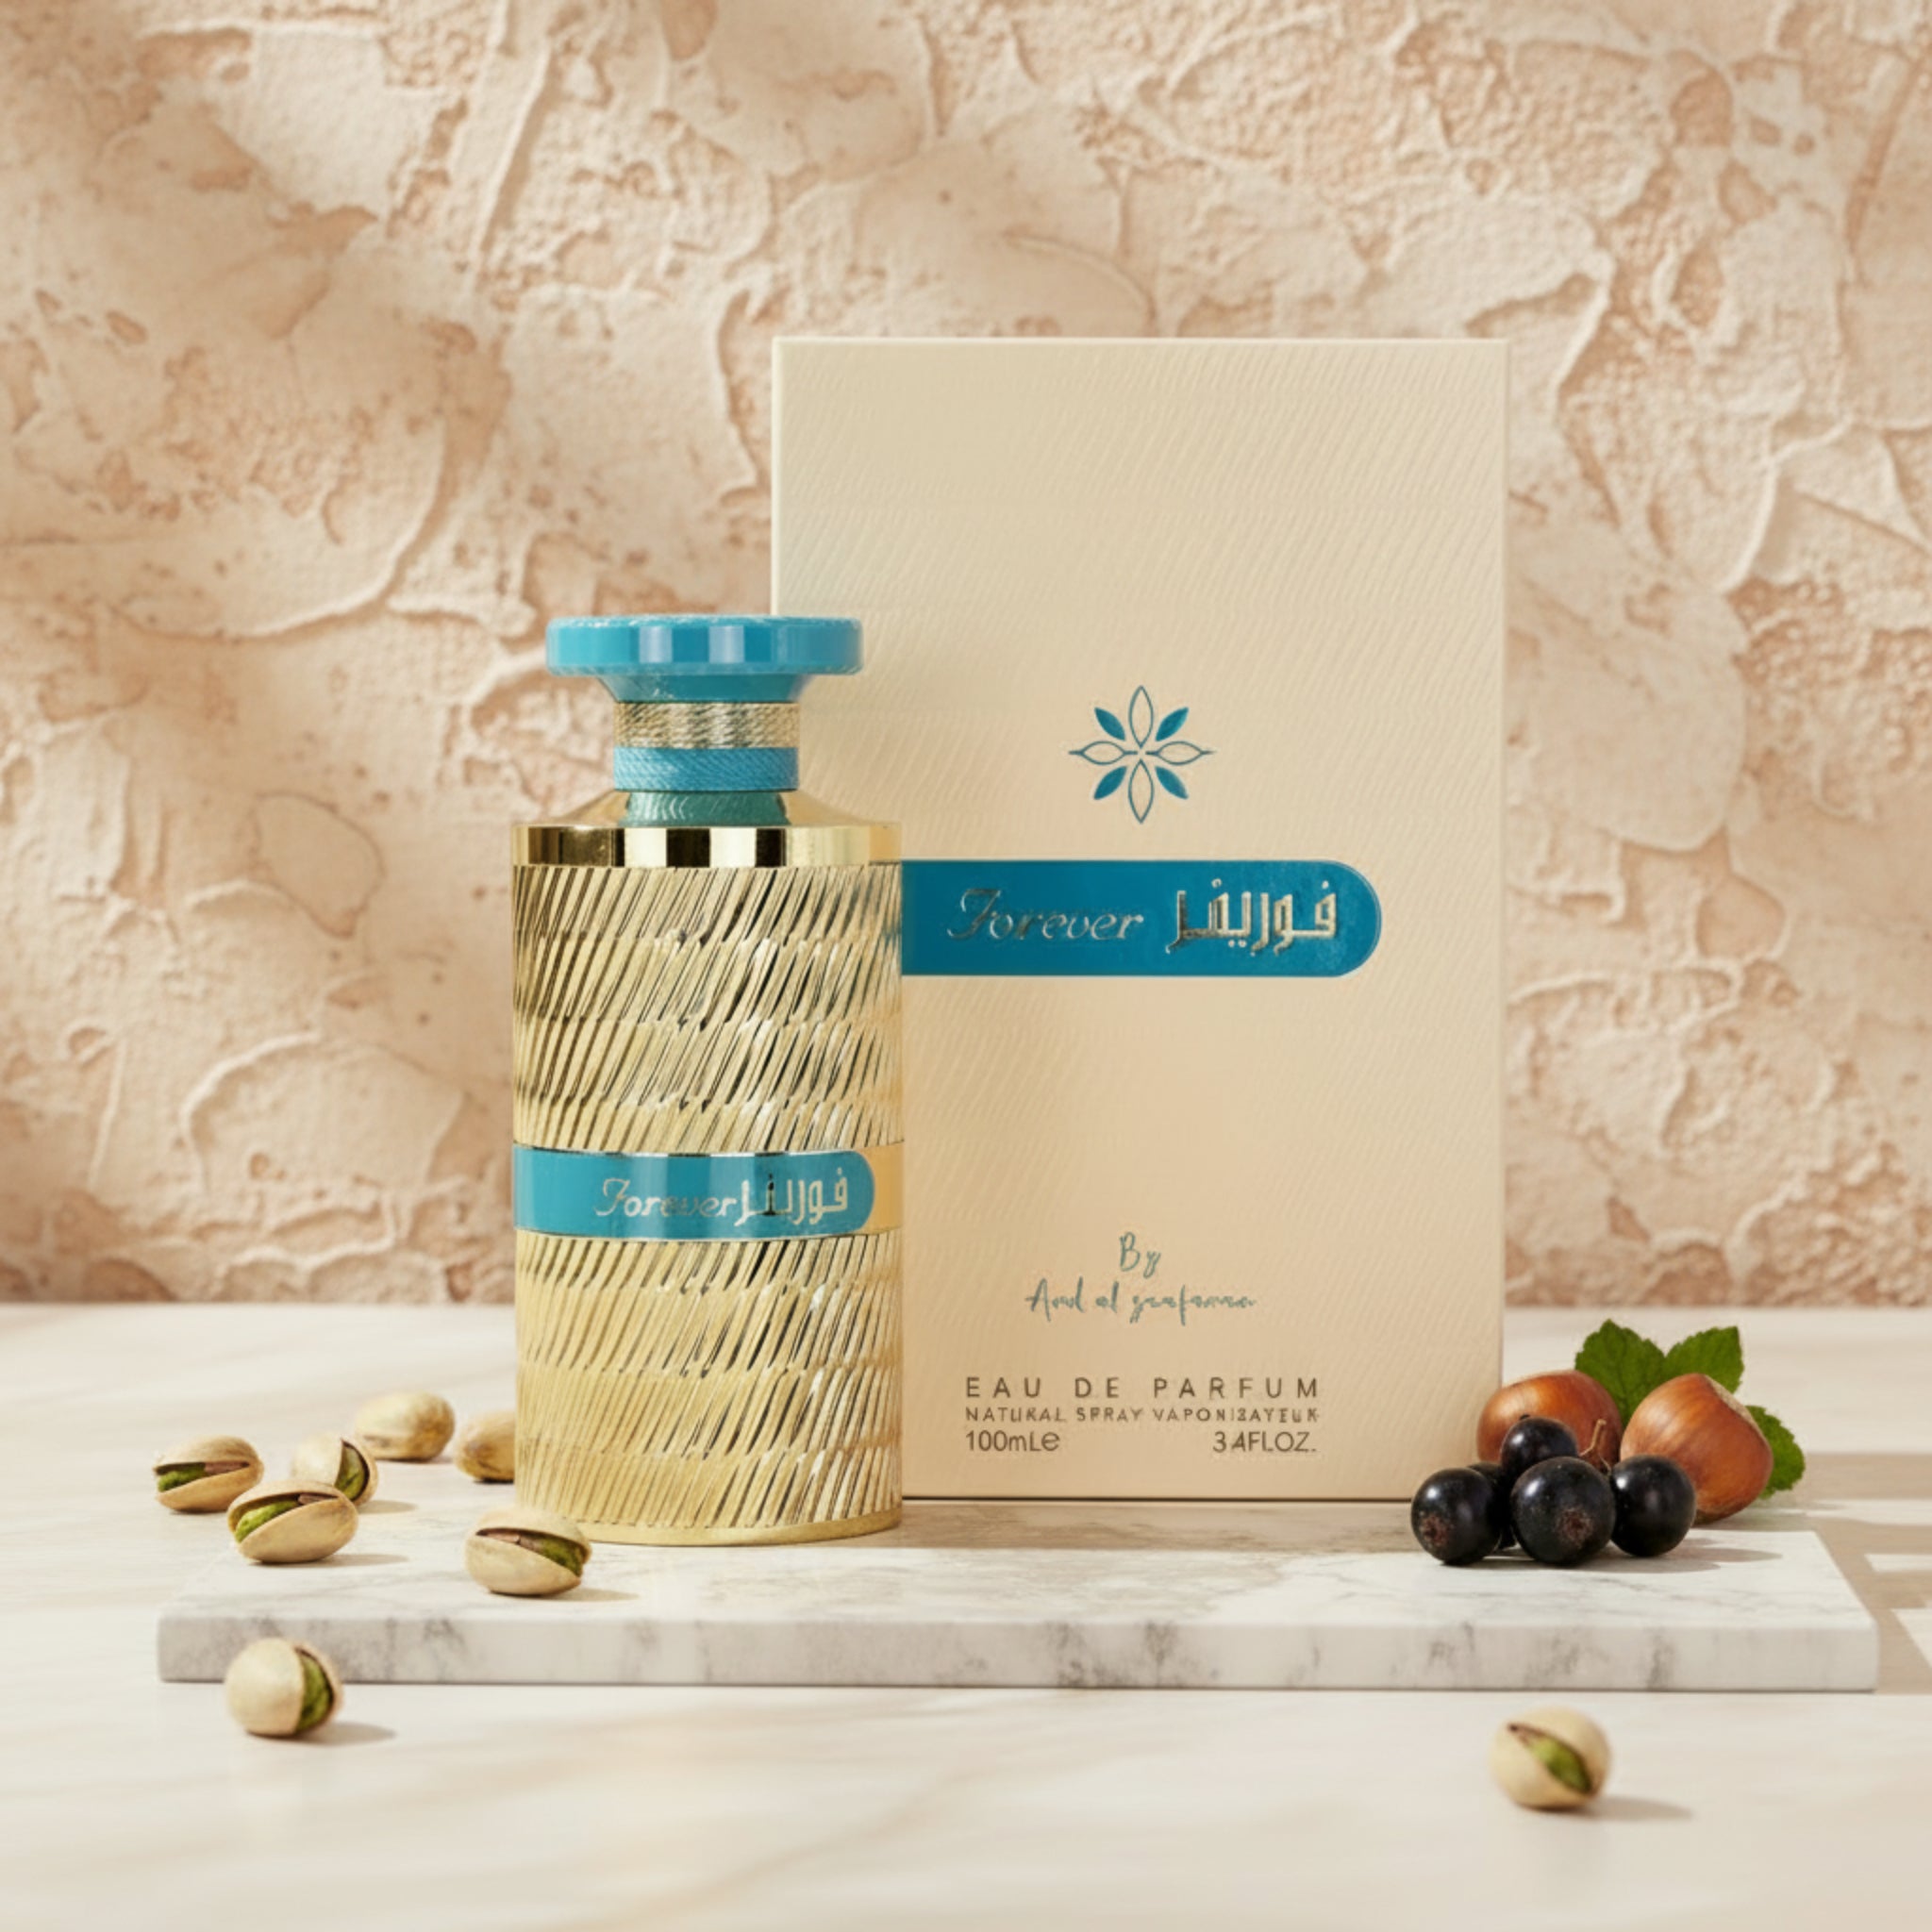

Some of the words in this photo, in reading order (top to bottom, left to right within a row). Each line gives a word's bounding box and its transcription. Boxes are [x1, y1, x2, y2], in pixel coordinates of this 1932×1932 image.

[947, 888, 1144, 941] Forever
[594, 1178, 737, 1217] Forever
[1120, 1231, 1161, 1278] By
[966, 1377, 1041, 1398] EAU
[1075, 1377, 1120, 1398] DE
[1154, 1377, 1318, 1398] PARFUM
[1076, 1407, 1143, 1423] SPRAY
